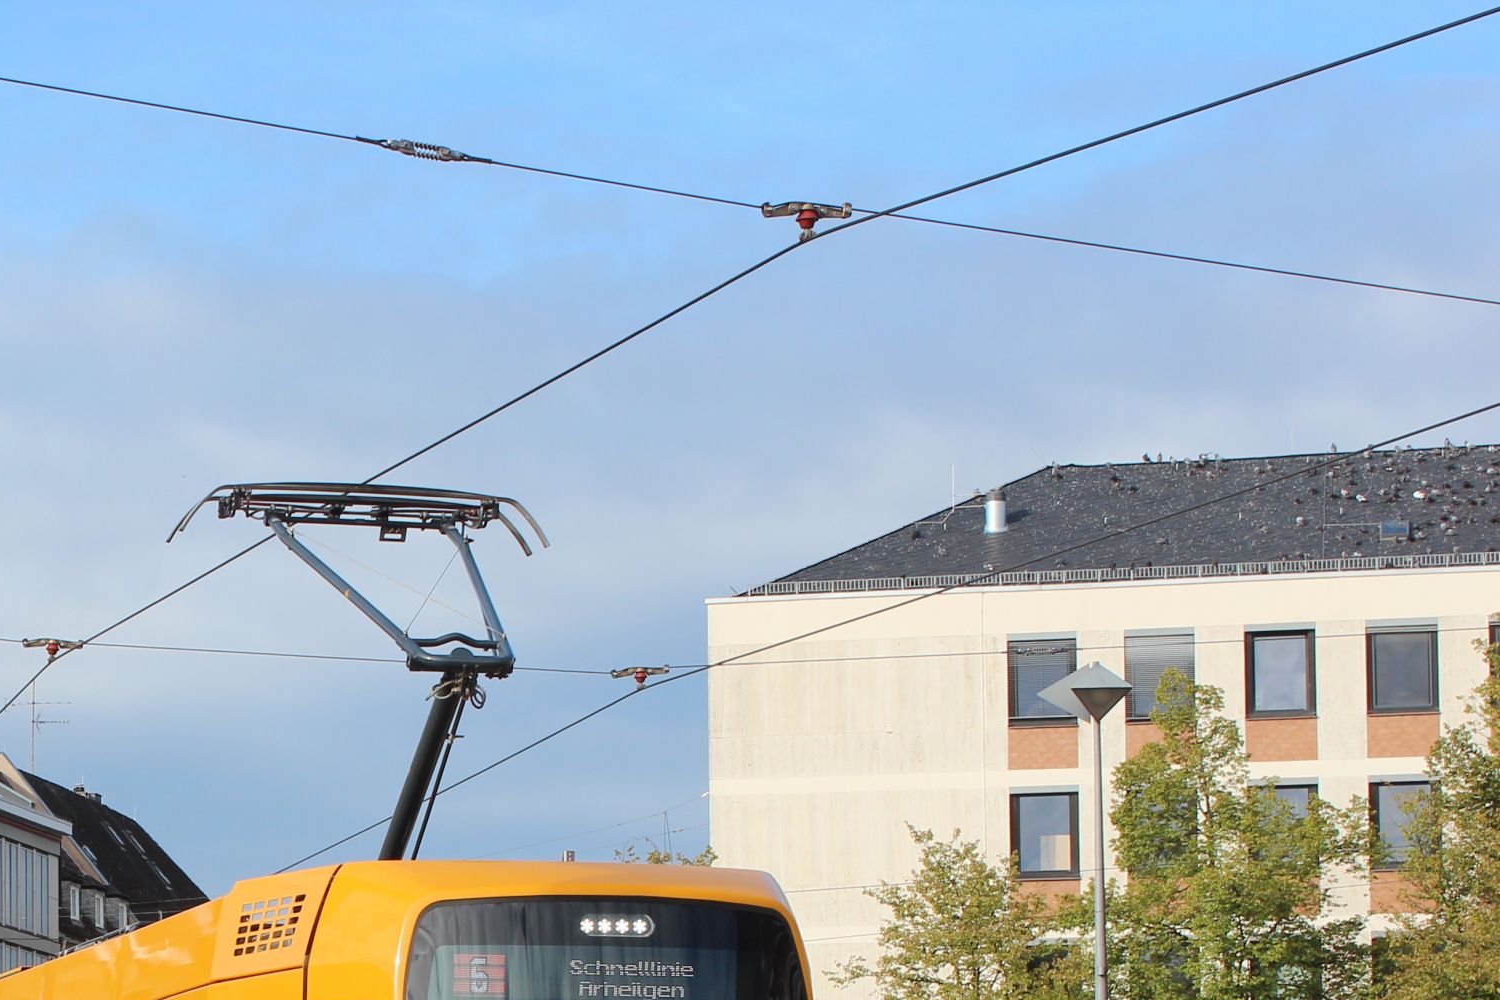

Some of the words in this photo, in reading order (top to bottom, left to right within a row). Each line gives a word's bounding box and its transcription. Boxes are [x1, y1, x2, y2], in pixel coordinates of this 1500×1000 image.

[470, 957, 488, 993] 6
[569, 959, 695, 977] Schnelllinie
[578, 981, 685, 1000] Arheilgen
